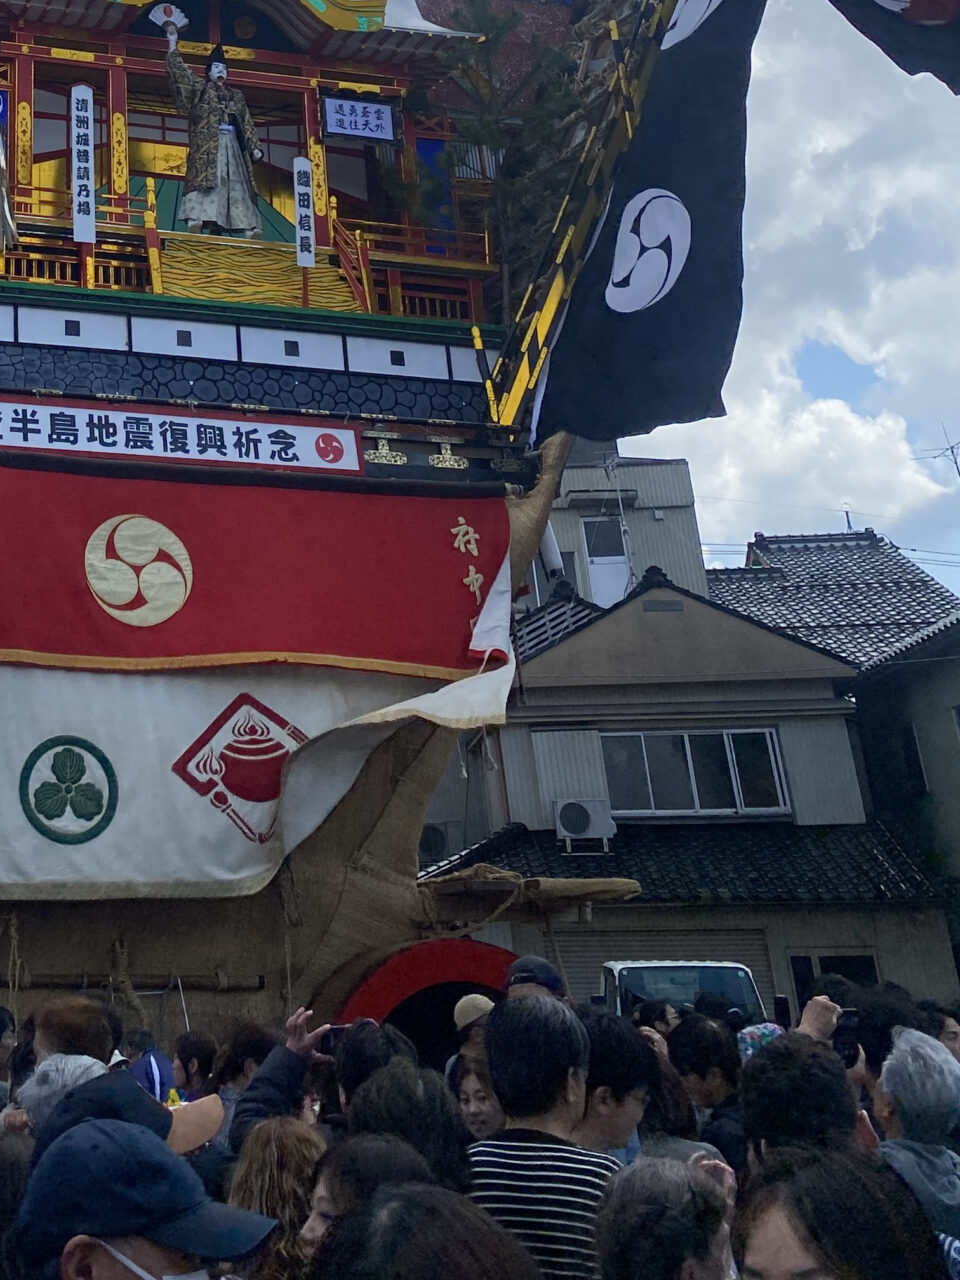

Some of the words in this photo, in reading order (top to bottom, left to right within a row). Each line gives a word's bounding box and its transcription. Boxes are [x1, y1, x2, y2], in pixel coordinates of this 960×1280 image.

[296, 169, 312, 254] 織田信長
[450, 516, 485, 632] 府中
